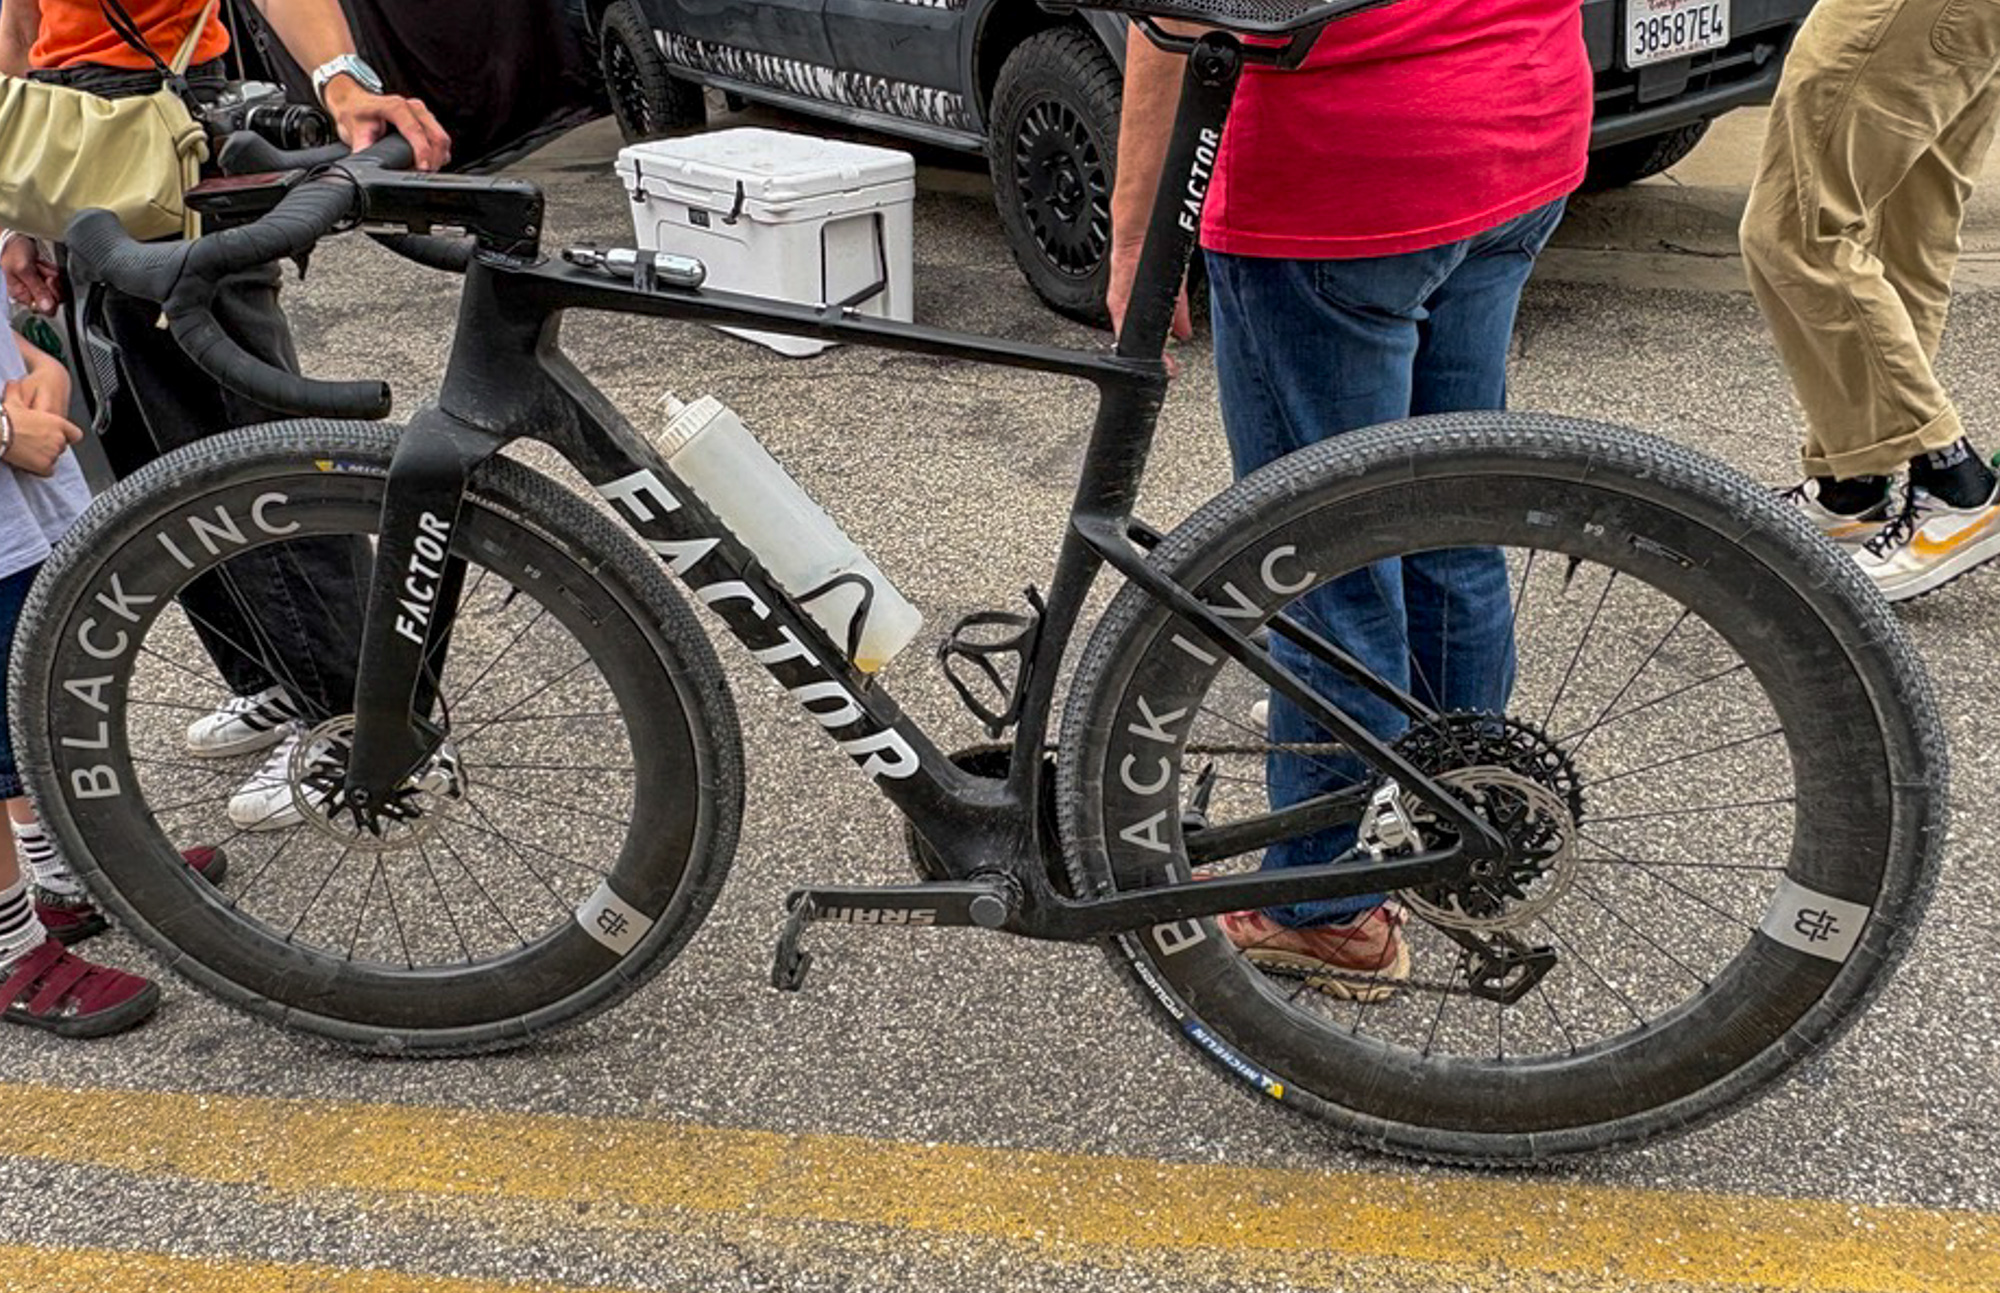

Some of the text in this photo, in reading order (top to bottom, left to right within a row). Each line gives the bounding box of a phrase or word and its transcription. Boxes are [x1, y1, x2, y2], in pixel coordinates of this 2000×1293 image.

[1634, 4, 1723, 55] 38587E4
[1178, 127, 1220, 232] FACTOR
[395, 511, 451, 645] FACTOR
[594, 468, 921, 781] FACTOR
[61, 492, 301, 800] BLACK INC
[1119, 695, 1207, 957] BACK
[1191, 1026, 1261, 1082] MICHELIN
